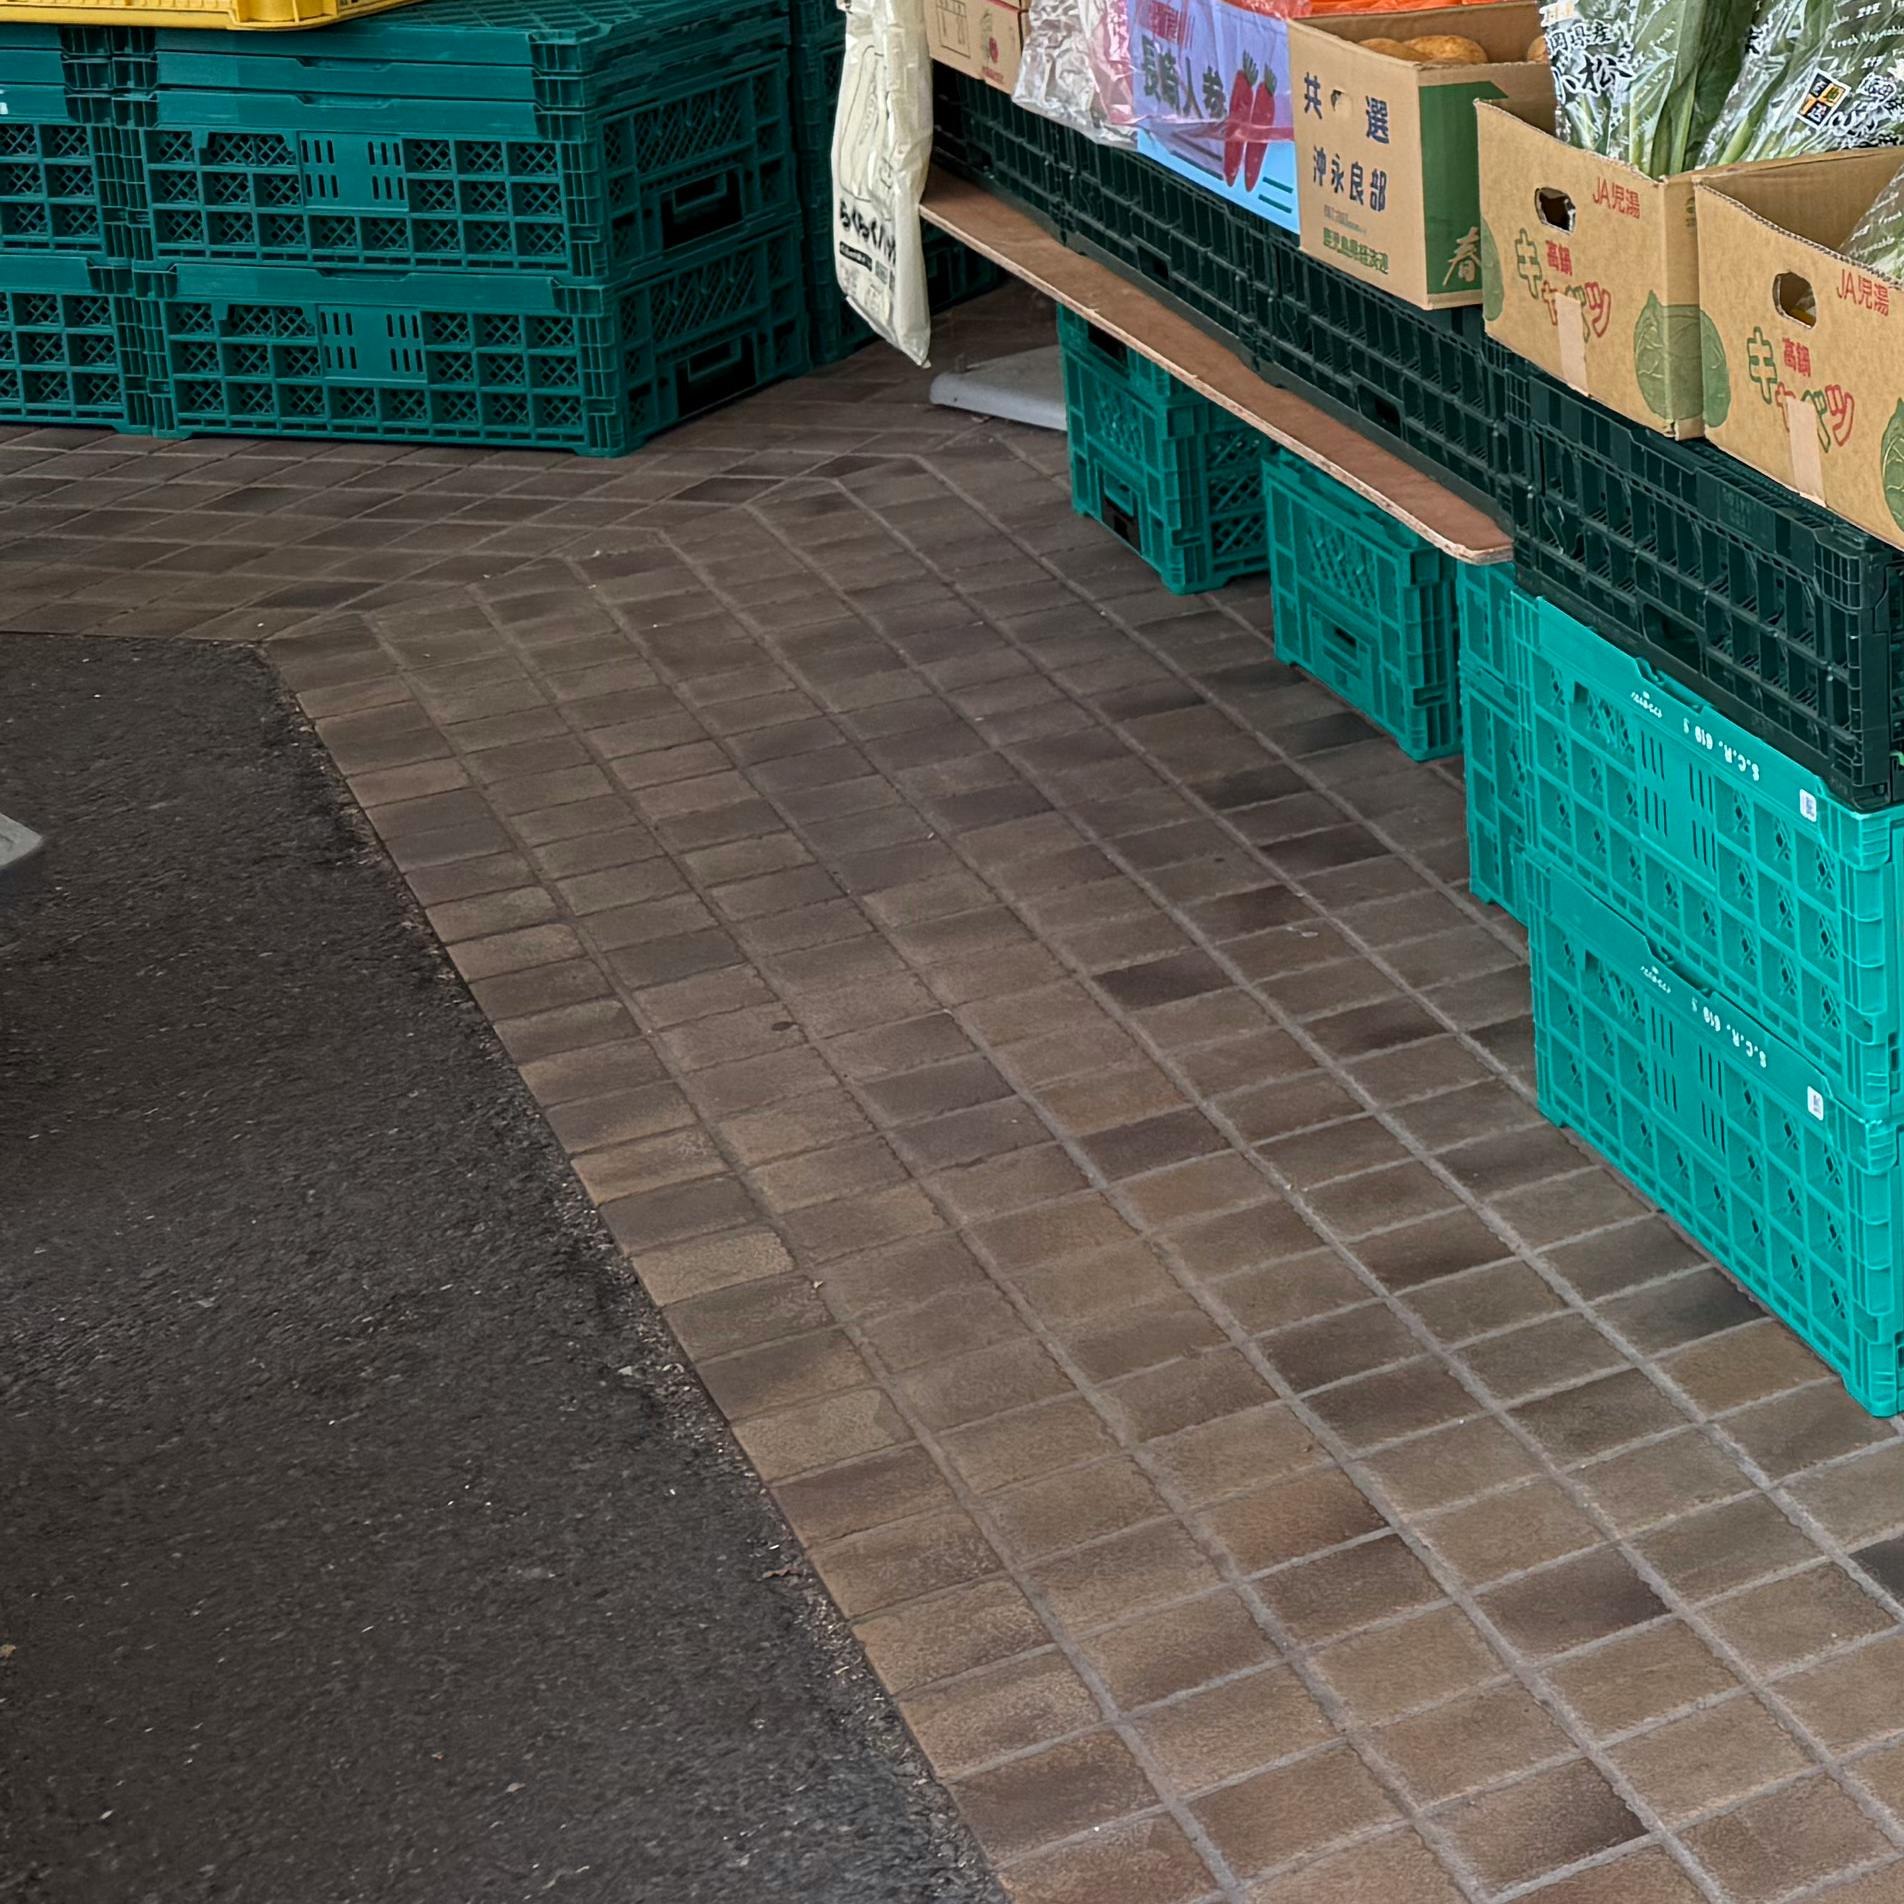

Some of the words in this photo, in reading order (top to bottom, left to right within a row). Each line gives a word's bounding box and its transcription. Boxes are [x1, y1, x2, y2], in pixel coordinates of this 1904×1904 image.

[1313, 145, 1388, 213] 沖永良部
[1593, 176, 1640, 219] JA児湯
[1837, 269, 1889, 316] JA児湯
